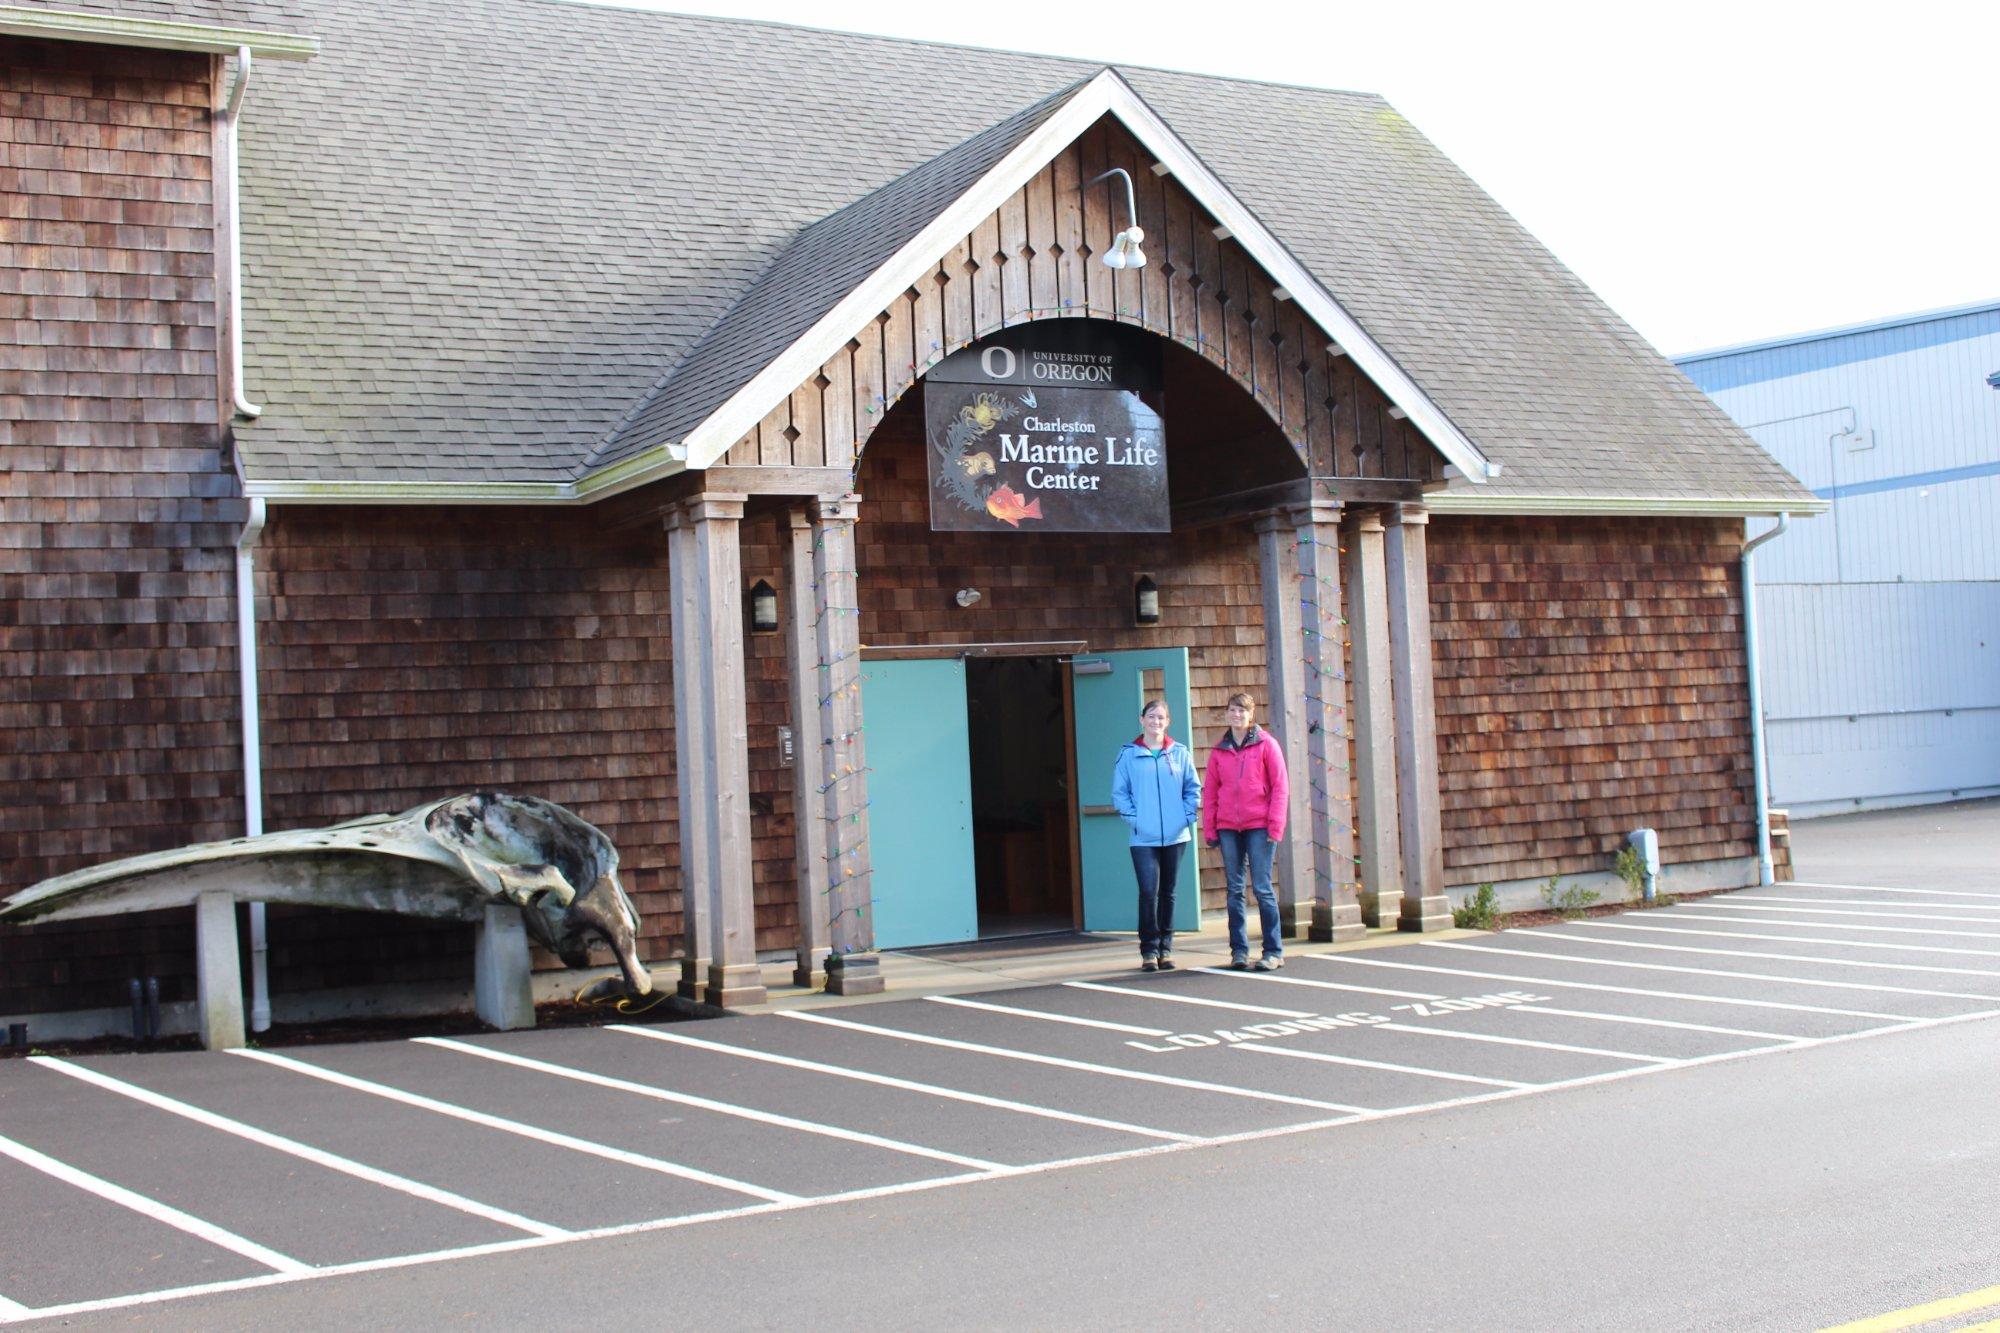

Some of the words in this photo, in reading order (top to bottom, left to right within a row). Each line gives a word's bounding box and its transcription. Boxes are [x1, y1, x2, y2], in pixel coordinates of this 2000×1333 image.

[981, 346, 1016, 378] O
[1033, 351, 1096, 363] UNIVERSITY
[1099, 355, 1113, 364] OF
[1033, 362, 1113, 382] OREGON
[1023, 416, 1096, 433] Charleston
[999, 433, 1099, 464] Marine
[1105, 437, 1158, 466] Life
[1026, 466, 1100, 490] Center
[1124, 1012, 1391, 1052] LOADING
[1390, 991, 1553, 1017] ZONE
